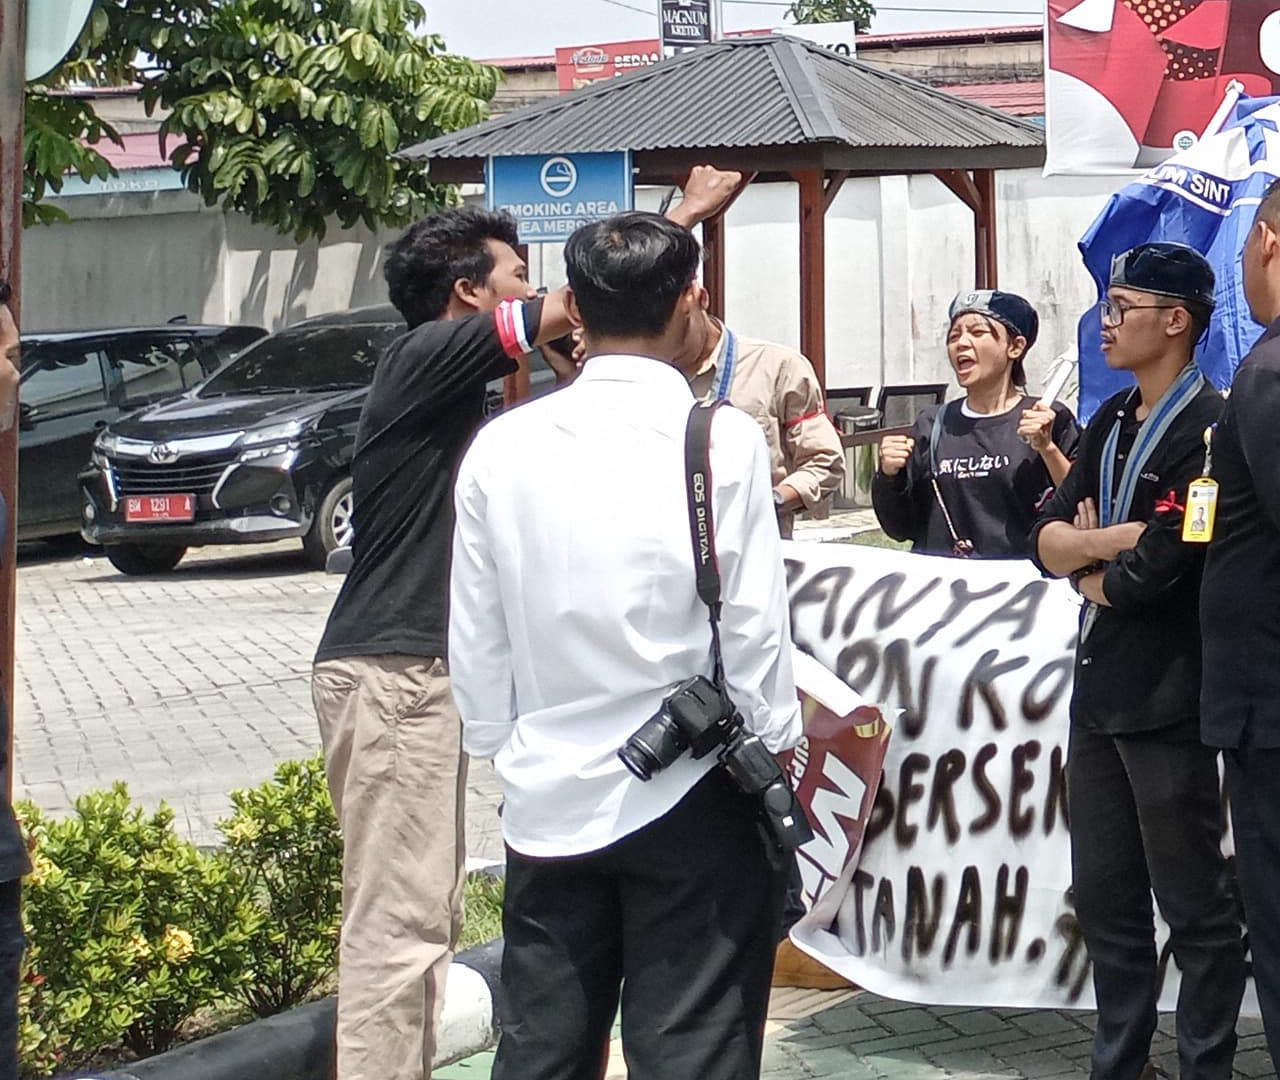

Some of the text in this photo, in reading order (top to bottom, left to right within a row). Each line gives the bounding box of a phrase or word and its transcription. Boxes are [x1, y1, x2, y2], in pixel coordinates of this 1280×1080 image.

[663, 10, 709, 26] MAGNUM
[1190, 173, 1231, 205] SINT
[575, 201, 618, 215] AREA
[939, 454, 1009, 475] 気にしない
[150, 497, 170, 512] 1291
[693, 472, 710, 565] EOS DIGITAL
